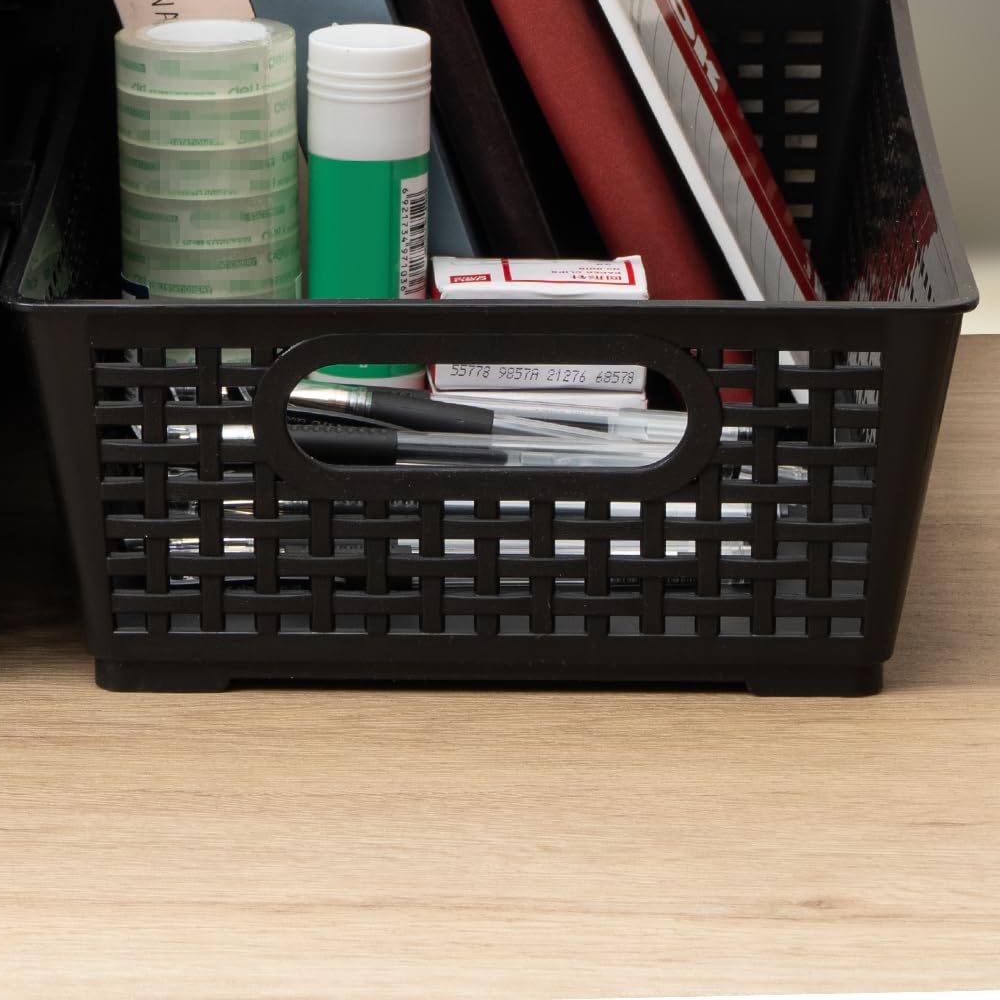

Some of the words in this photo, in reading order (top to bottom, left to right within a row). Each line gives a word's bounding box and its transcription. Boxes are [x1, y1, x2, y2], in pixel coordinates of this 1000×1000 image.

[401, 200, 409, 243] 921734
[401, 248, 409, 292] 971036
[450, 364, 491, 379] 55778
[546, 367, 586, 383] 21276
[595, 369, 635, 385] 68578
